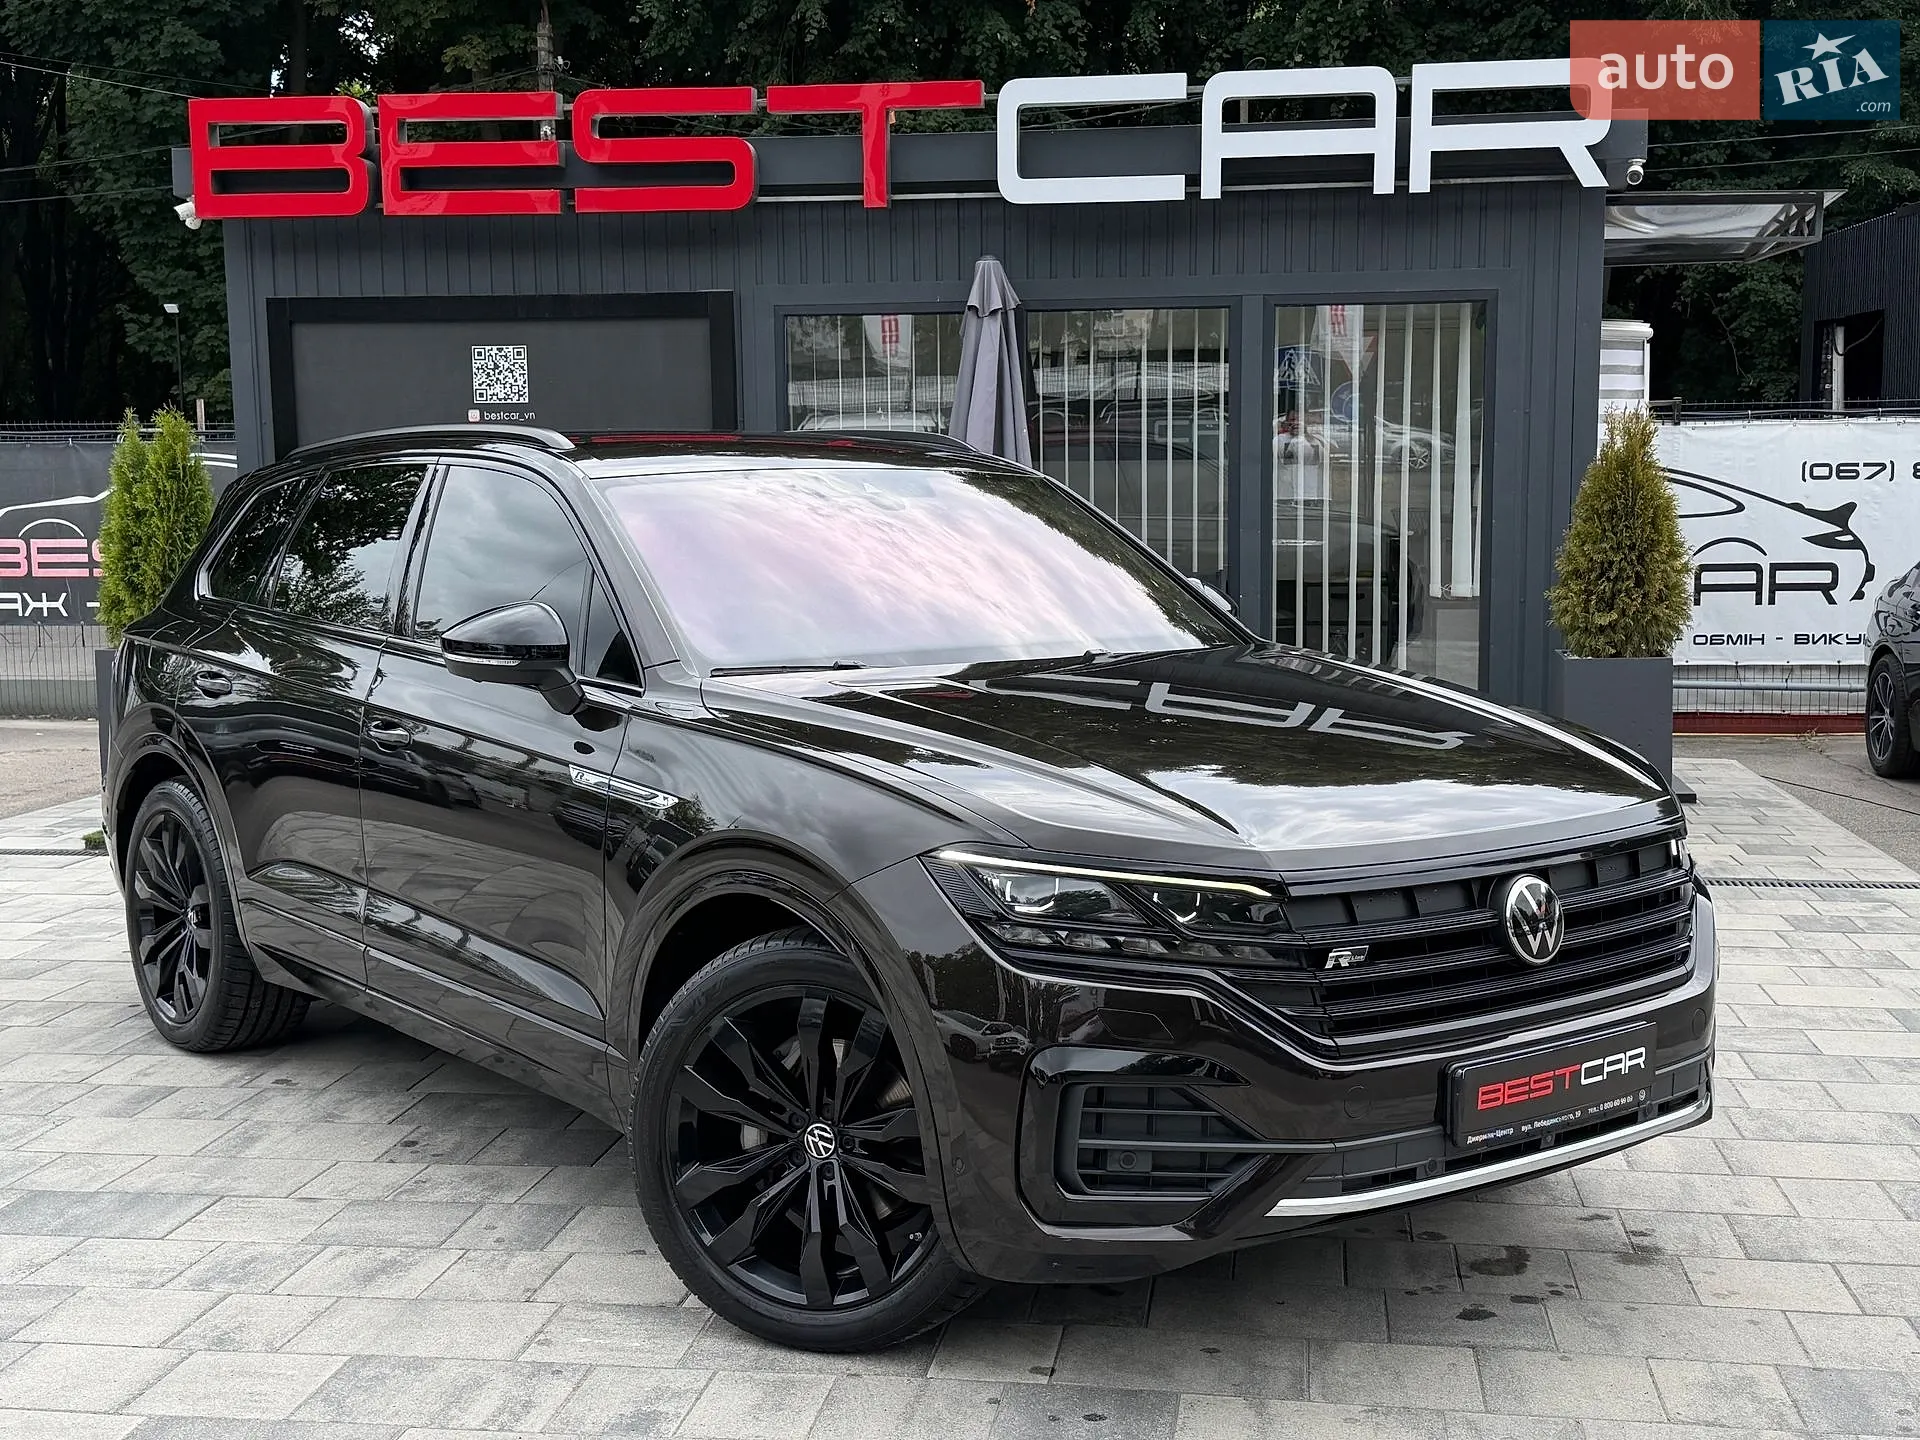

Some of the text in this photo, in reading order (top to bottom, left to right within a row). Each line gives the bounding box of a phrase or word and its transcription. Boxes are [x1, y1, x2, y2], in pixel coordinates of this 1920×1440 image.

[484, 411, 536, 421] bestcar_vn
[1802, 460, 1895, 482] (067)
[1693, 634, 1765, 646] ОБМІН
[1793, 633, 1866, 646] ВИКУ
